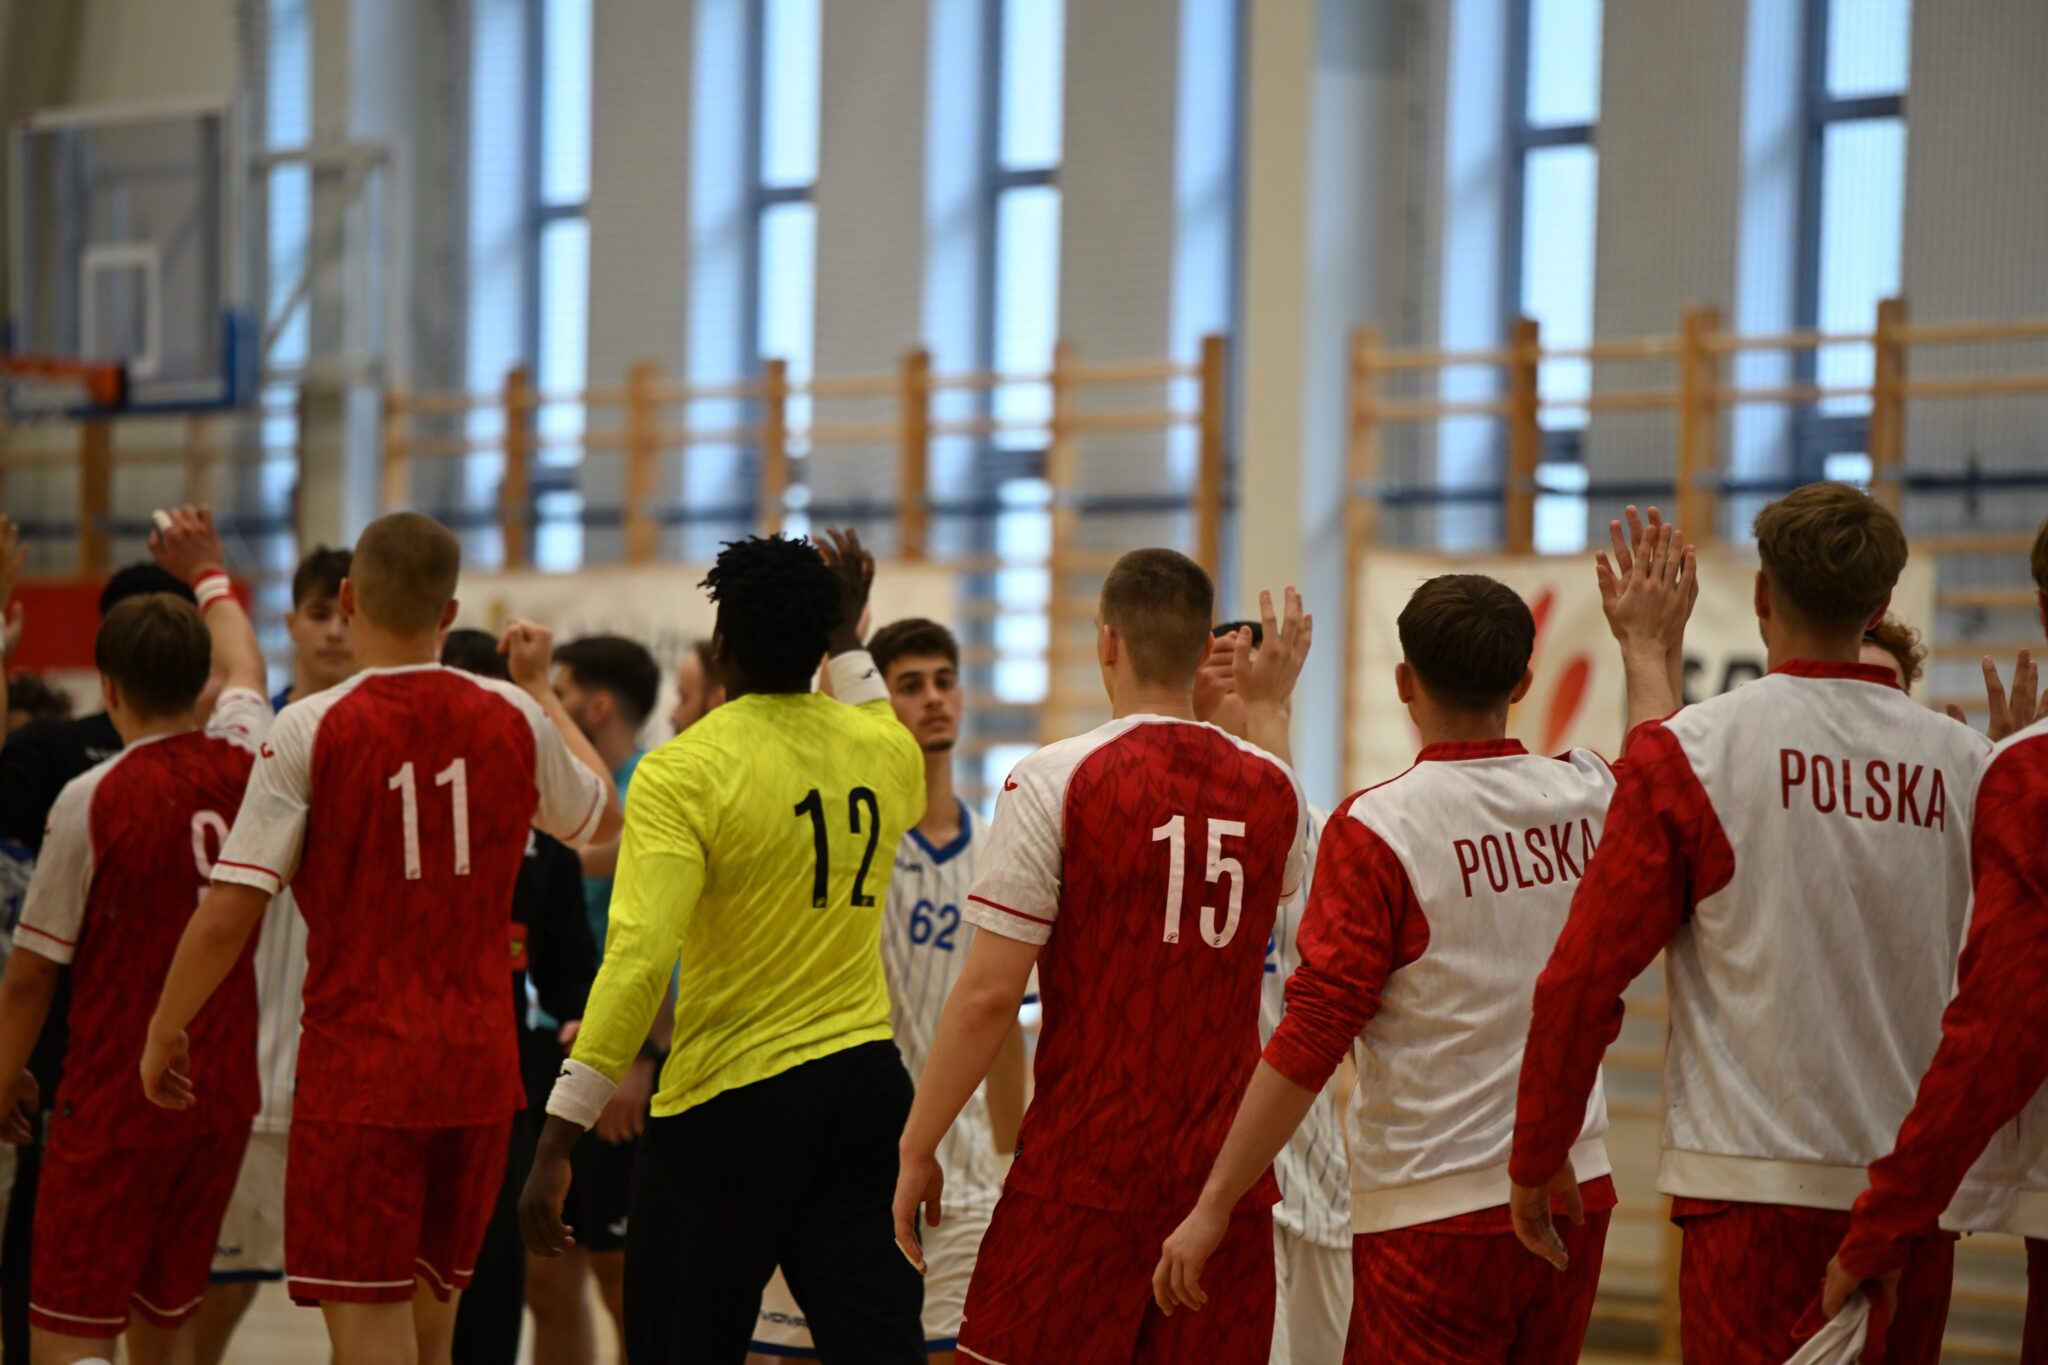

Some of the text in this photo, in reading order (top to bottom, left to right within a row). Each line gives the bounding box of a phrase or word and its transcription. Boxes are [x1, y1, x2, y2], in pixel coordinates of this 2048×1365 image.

[388, 758, 470, 880] 11
[1780, 748, 1945, 833] POLSKA
[794, 786, 880, 909] 12
[1151, 814, 1246, 949] 15
[1453, 818, 1597, 898] POLSKA
[910, 899, 961, 952] 62
